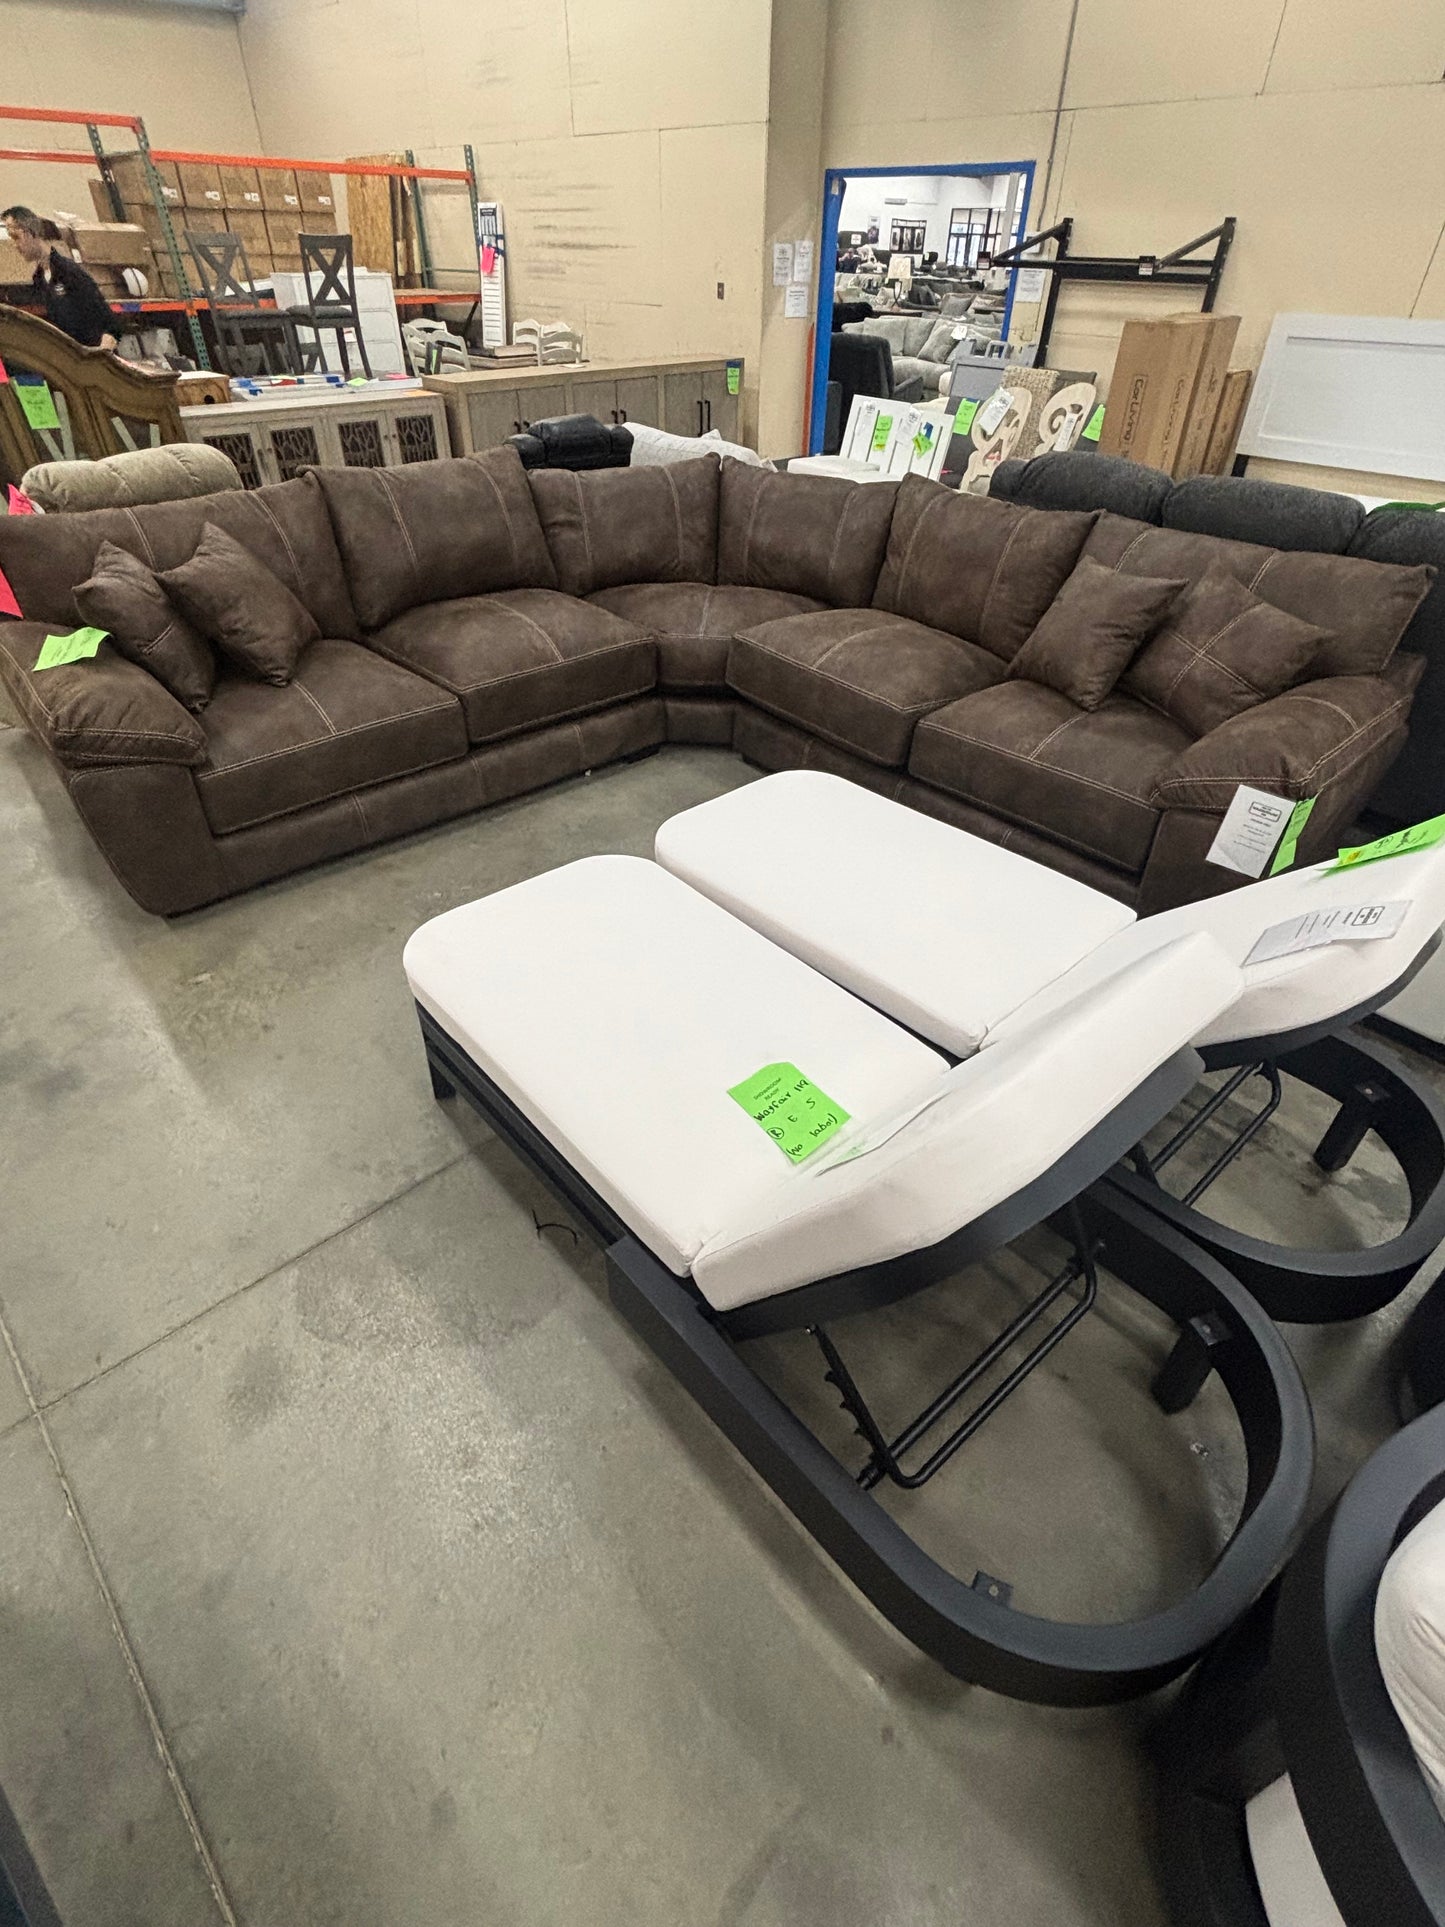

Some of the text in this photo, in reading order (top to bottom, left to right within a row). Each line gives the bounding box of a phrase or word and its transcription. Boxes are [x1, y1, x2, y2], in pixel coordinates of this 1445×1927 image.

[1123, 378, 1145, 442] CorLiving
[753, 1091, 791, 1121] Wayfair
[787, 1114, 798, 1123] E
